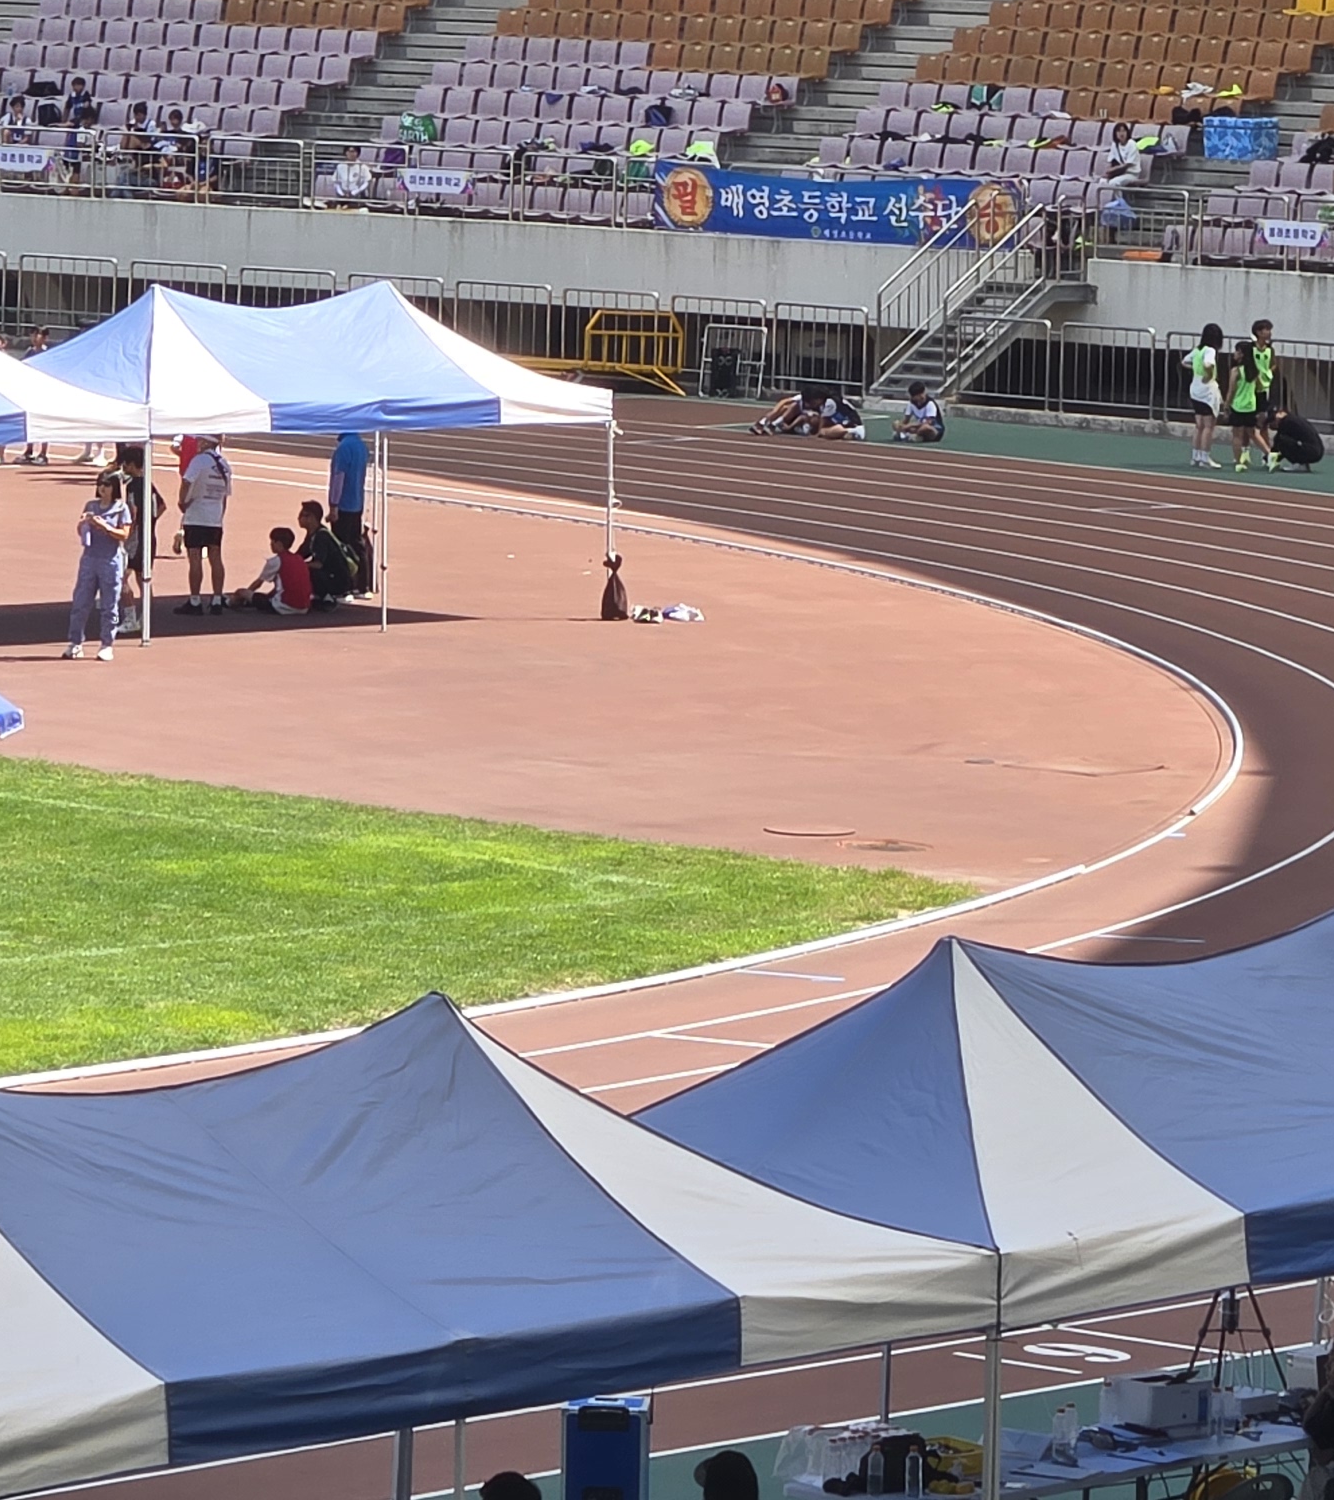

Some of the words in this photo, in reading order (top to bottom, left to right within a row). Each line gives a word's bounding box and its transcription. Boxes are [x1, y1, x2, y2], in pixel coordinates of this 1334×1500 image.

[672, 177, 698, 216] 필
[719, 185, 878, 224] 배영초등학교
[883, 194, 962, 229] 선수단
